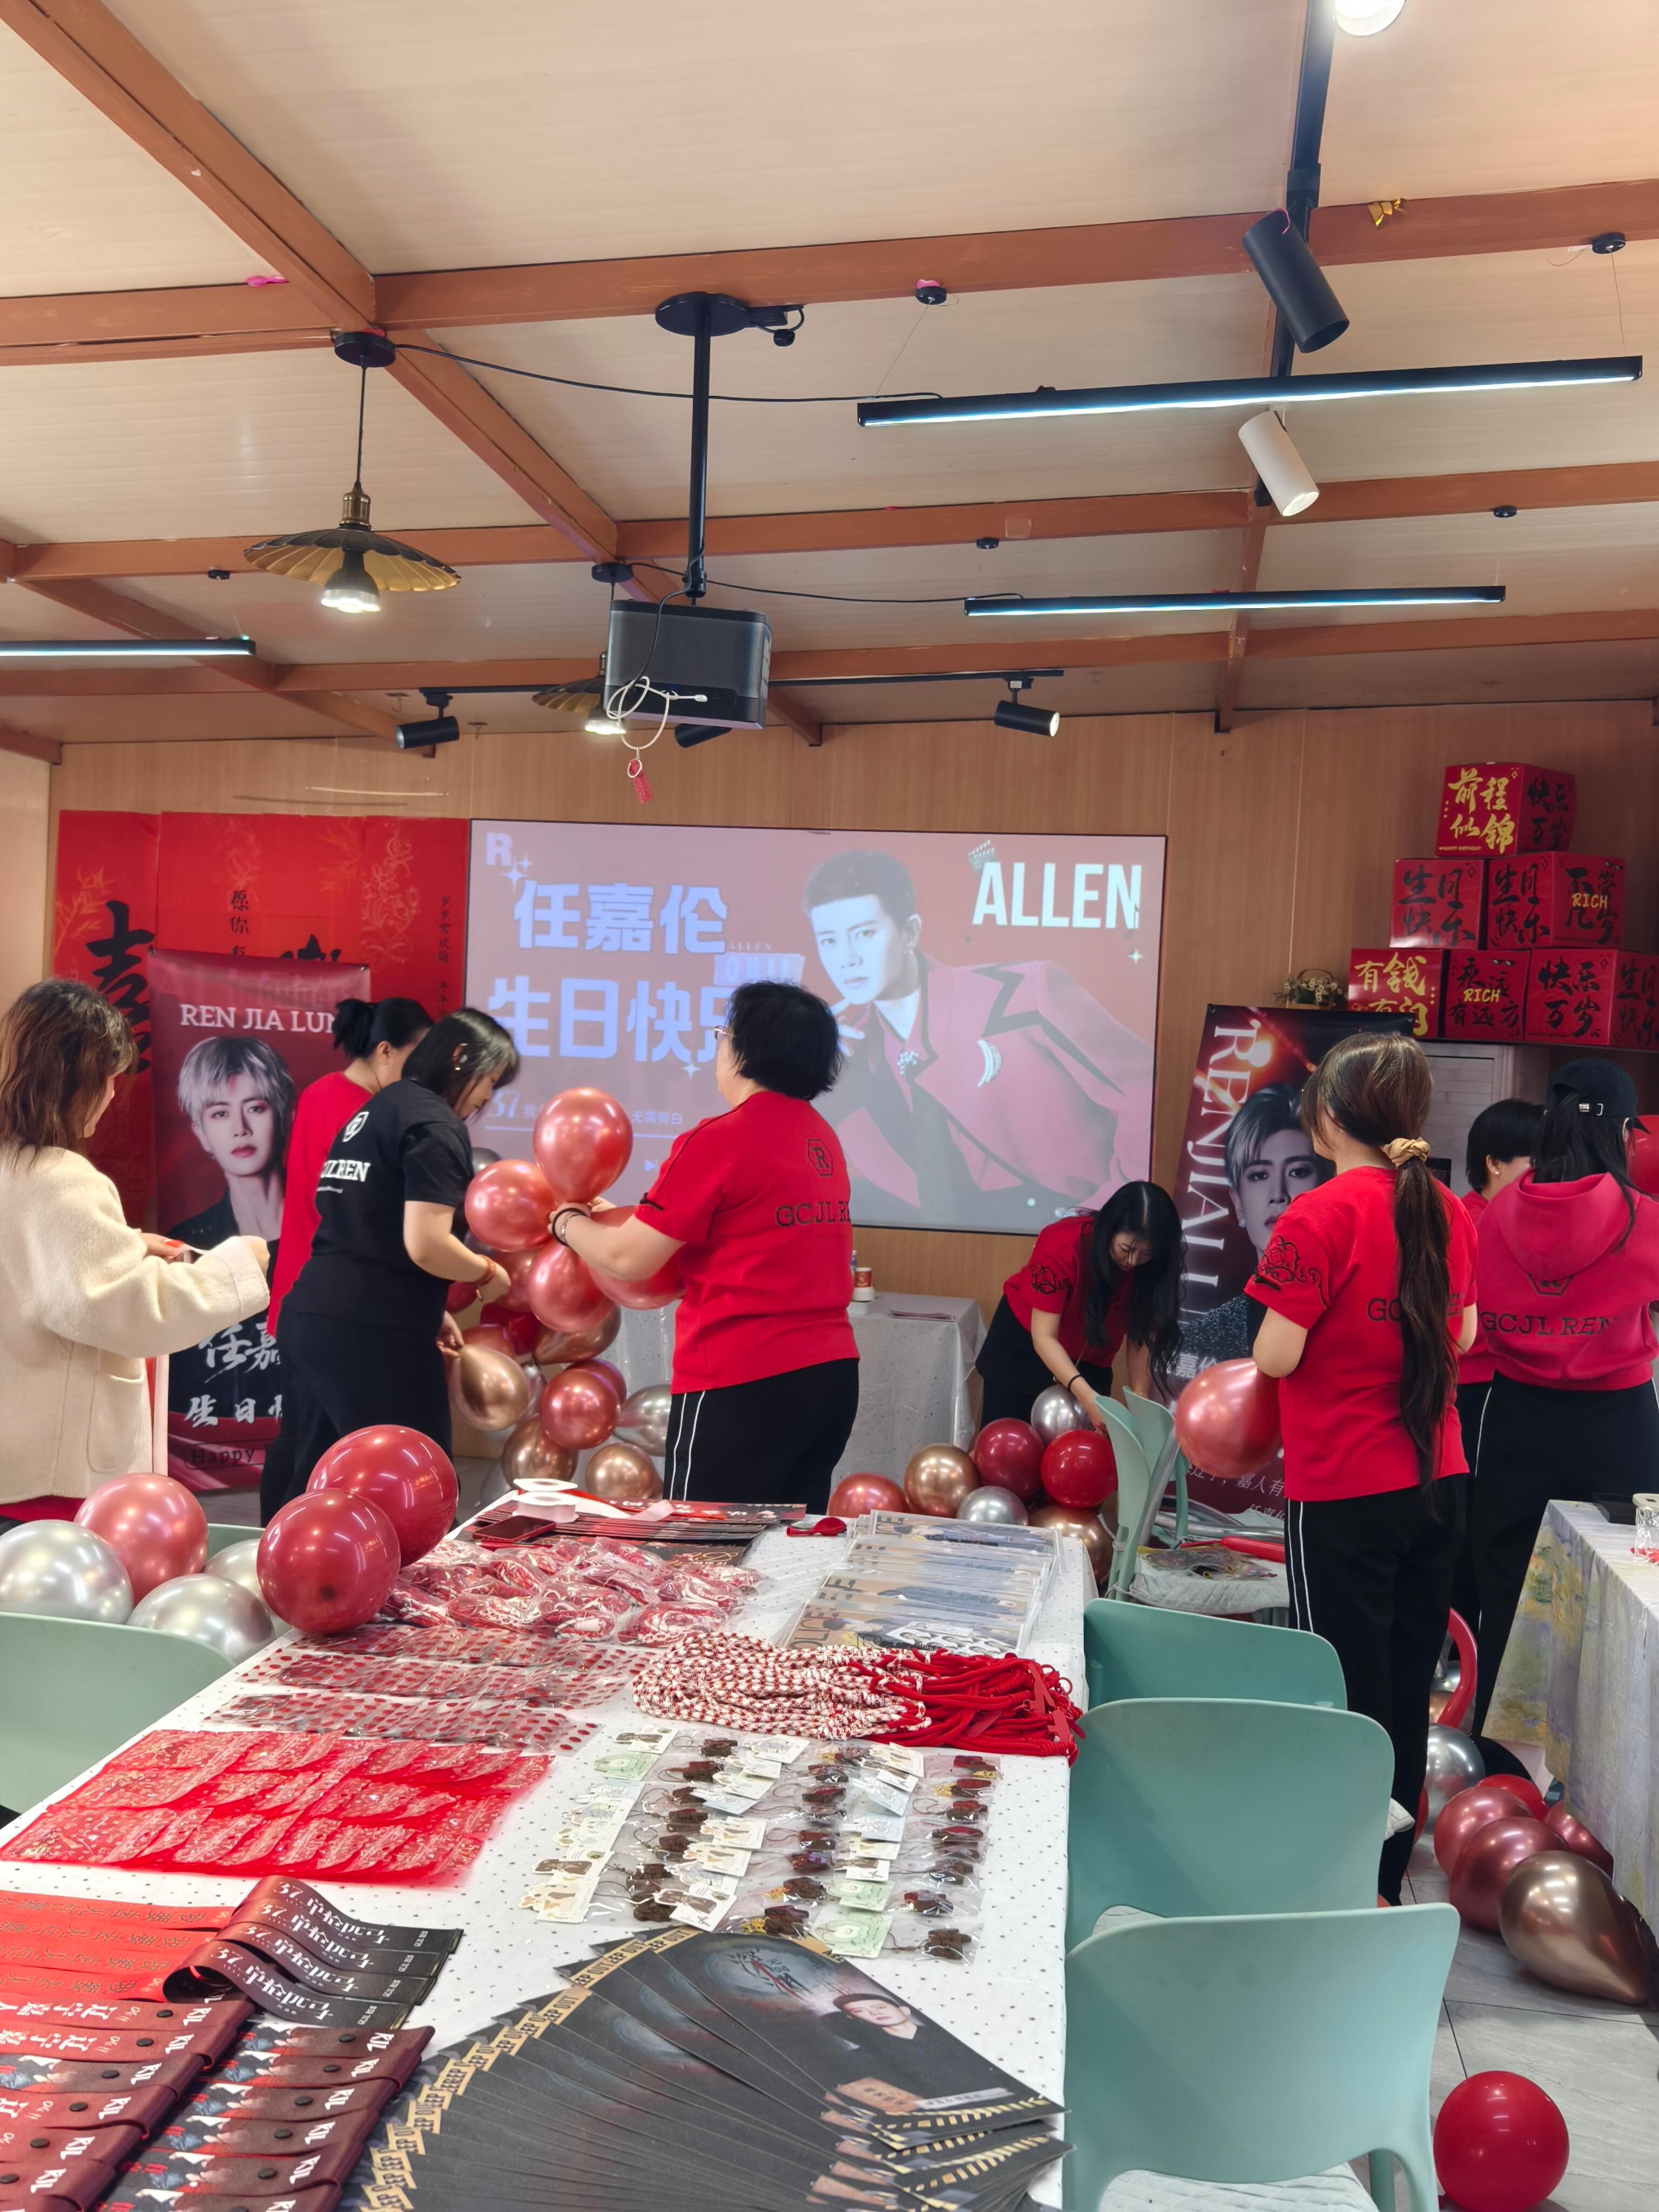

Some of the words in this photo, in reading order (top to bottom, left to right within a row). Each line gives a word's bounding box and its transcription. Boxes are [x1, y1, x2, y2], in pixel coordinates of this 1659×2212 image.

[1448, 767, 1509, 814] 前程
[485, 833, 512, 866] R
[972, 862, 1142, 929] ALLEN
[1398, 864, 1462, 905] 生日
[1492, 863, 1539, 905] 生日
[1572, 892, 1609, 909] RICH
[514, 880, 728, 954] 任嘉伦
[1463, 988, 1501, 1003] RICH
[180, 1003, 235, 1028] REN
[242, 1008, 285, 1030] JIA
[1544, 995, 1601, 1038] 万岁
[631, 1110, 683, 1126] 无需旁白
[812, 1147, 830, 1169] R
[775, 1202, 837, 1228] GCJL
[1481, 1311, 1554, 1336] GCJL
[1559, 1315, 1616, 1336] REN
[191, 1447, 255, 1466] Happy
[274, 1881, 304, 1899] 37
[255, 1903, 287, 1917] 37
[240, 1925, 271, 1938] 37
[211, 1946, 244, 1965] 37
